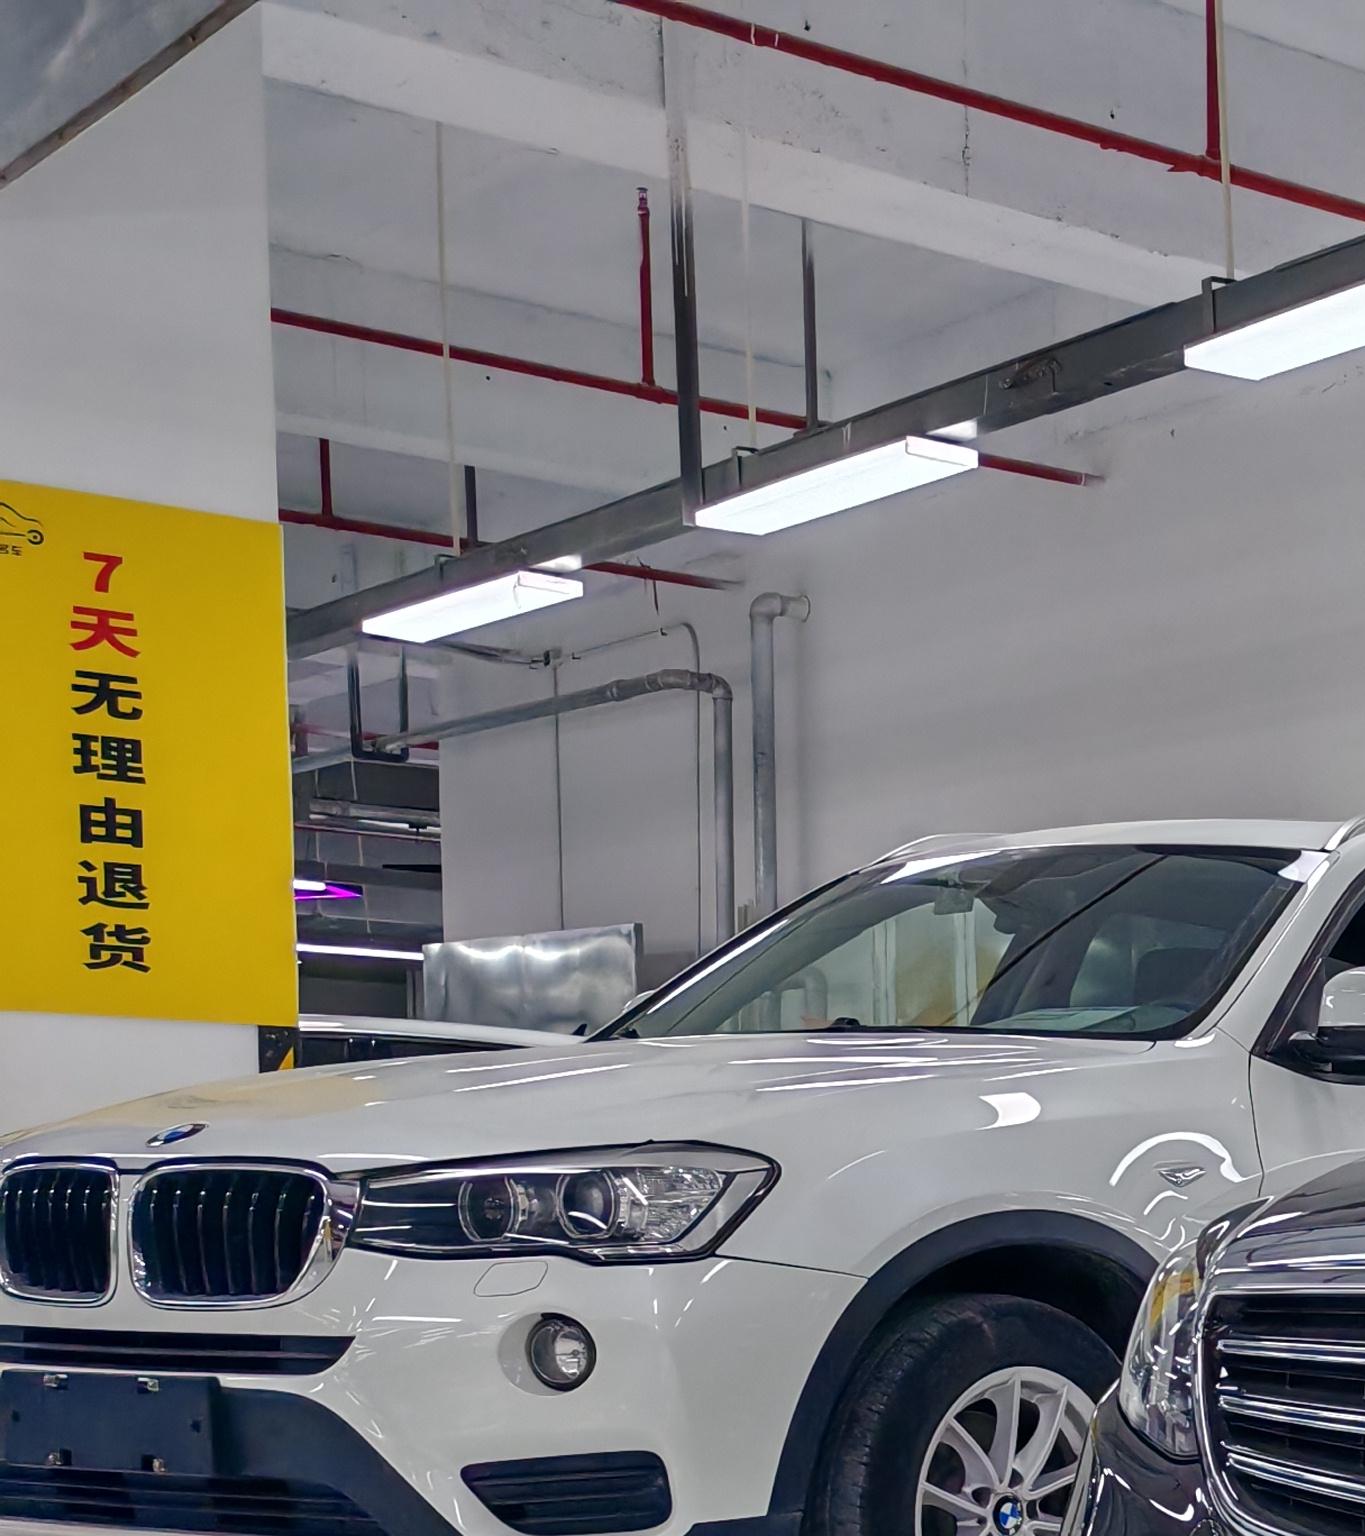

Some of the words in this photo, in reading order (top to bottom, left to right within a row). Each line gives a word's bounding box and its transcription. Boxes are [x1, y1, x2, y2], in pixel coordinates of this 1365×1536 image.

[69, 551, 151, 974] 7天无理由退货
